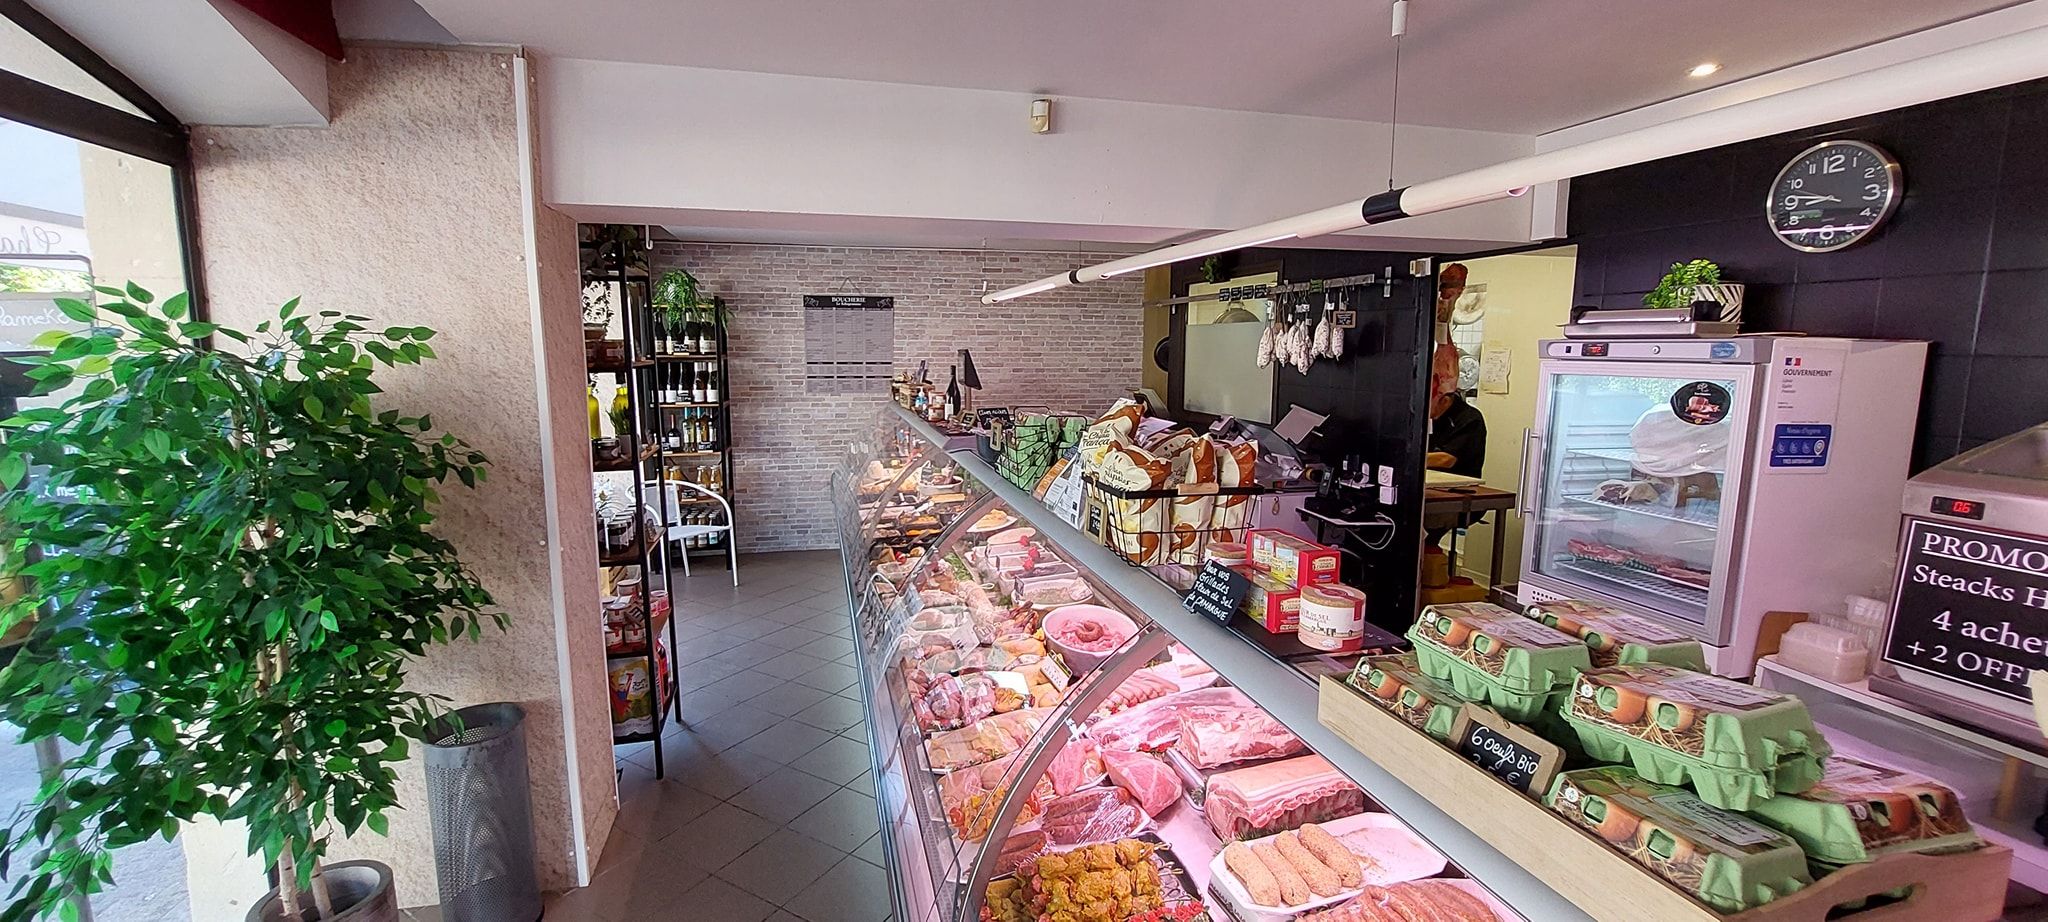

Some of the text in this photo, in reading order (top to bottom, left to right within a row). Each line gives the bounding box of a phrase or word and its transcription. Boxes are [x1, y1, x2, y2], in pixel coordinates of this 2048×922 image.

[1809, 164, 1816, 174] 11
[1823, 154, 1846, 174] 12
[1852, 156, 1858, 168] 1
[1864, 167, 1876, 178] 2
[1790, 178, 1804, 190] 10
[1862, 184, 1881, 200] 3
[1784, 194, 1798, 210] 9
[1860, 208, 1871, 216] 4
[1789, 215, 1800, 226] 8
[1820, 225, 1834, 240] 6
[1783, 368, 1832, 376] GOUVERNEMENT
[1200, 572, 1230, 595] Grillades
[1218, 570, 1230, 581] vos
[1913, 564, 2015, 602] Steacks
[1210, 591, 1220, 602] de
[1220, 596, 1234, 609] Sel
[1194, 596, 1229, 621] CAMARGUE
[1932, 610, 1952, 632] 4
[1931, 645, 1948, 664] 2
[1472, 726, 1490, 746] 6
